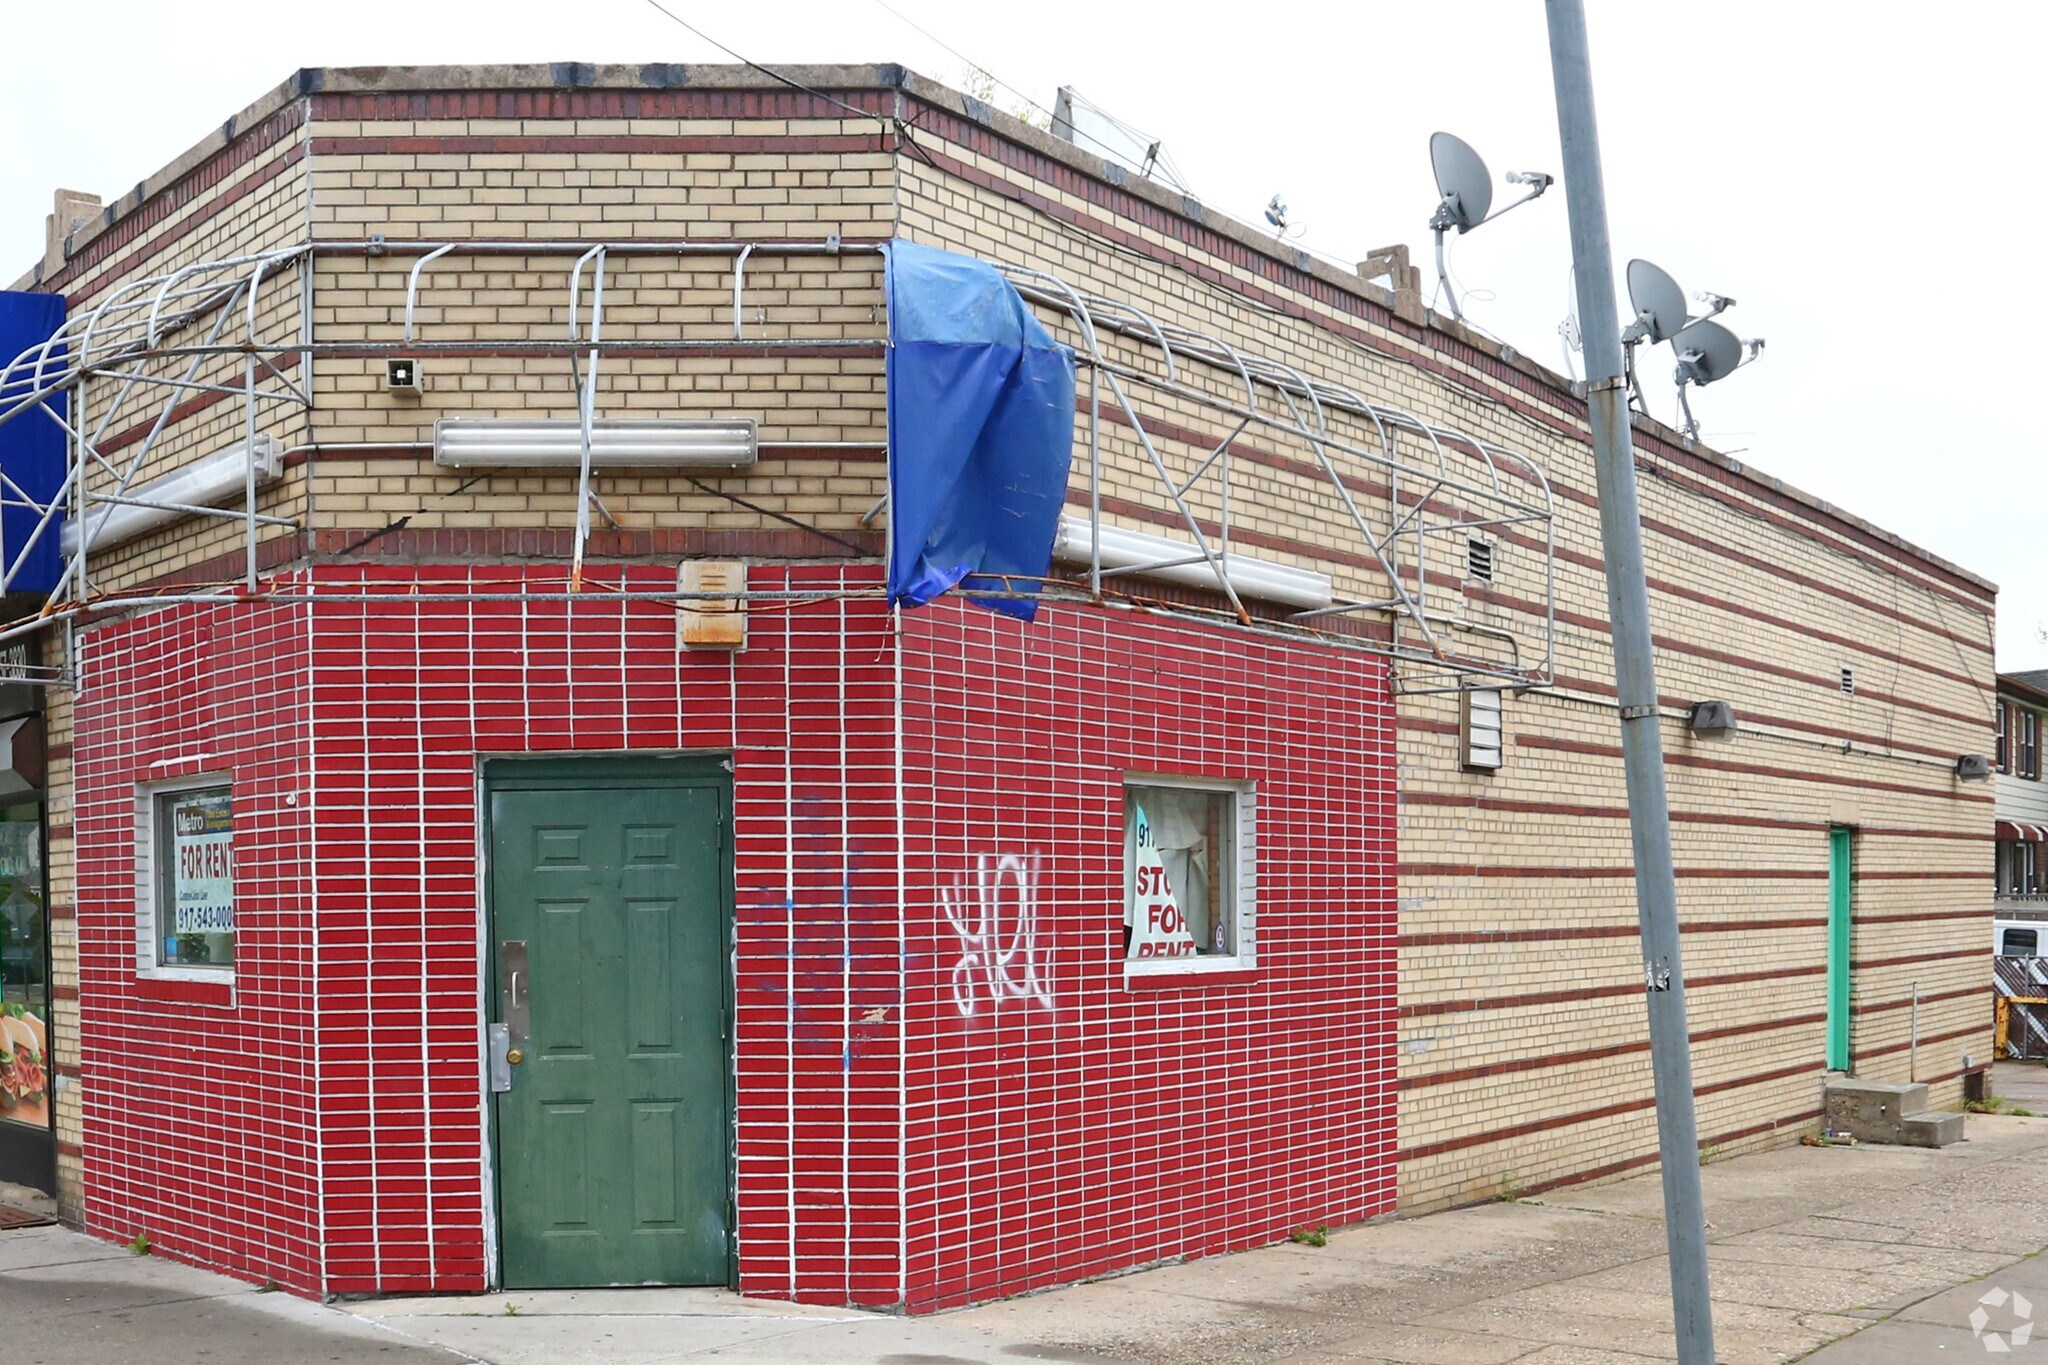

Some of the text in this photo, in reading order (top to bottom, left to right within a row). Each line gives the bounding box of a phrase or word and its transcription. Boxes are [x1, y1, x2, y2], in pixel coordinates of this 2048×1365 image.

[178, 811, 204, 832] Metro
[181, 842, 233, 879] FOR RENT
